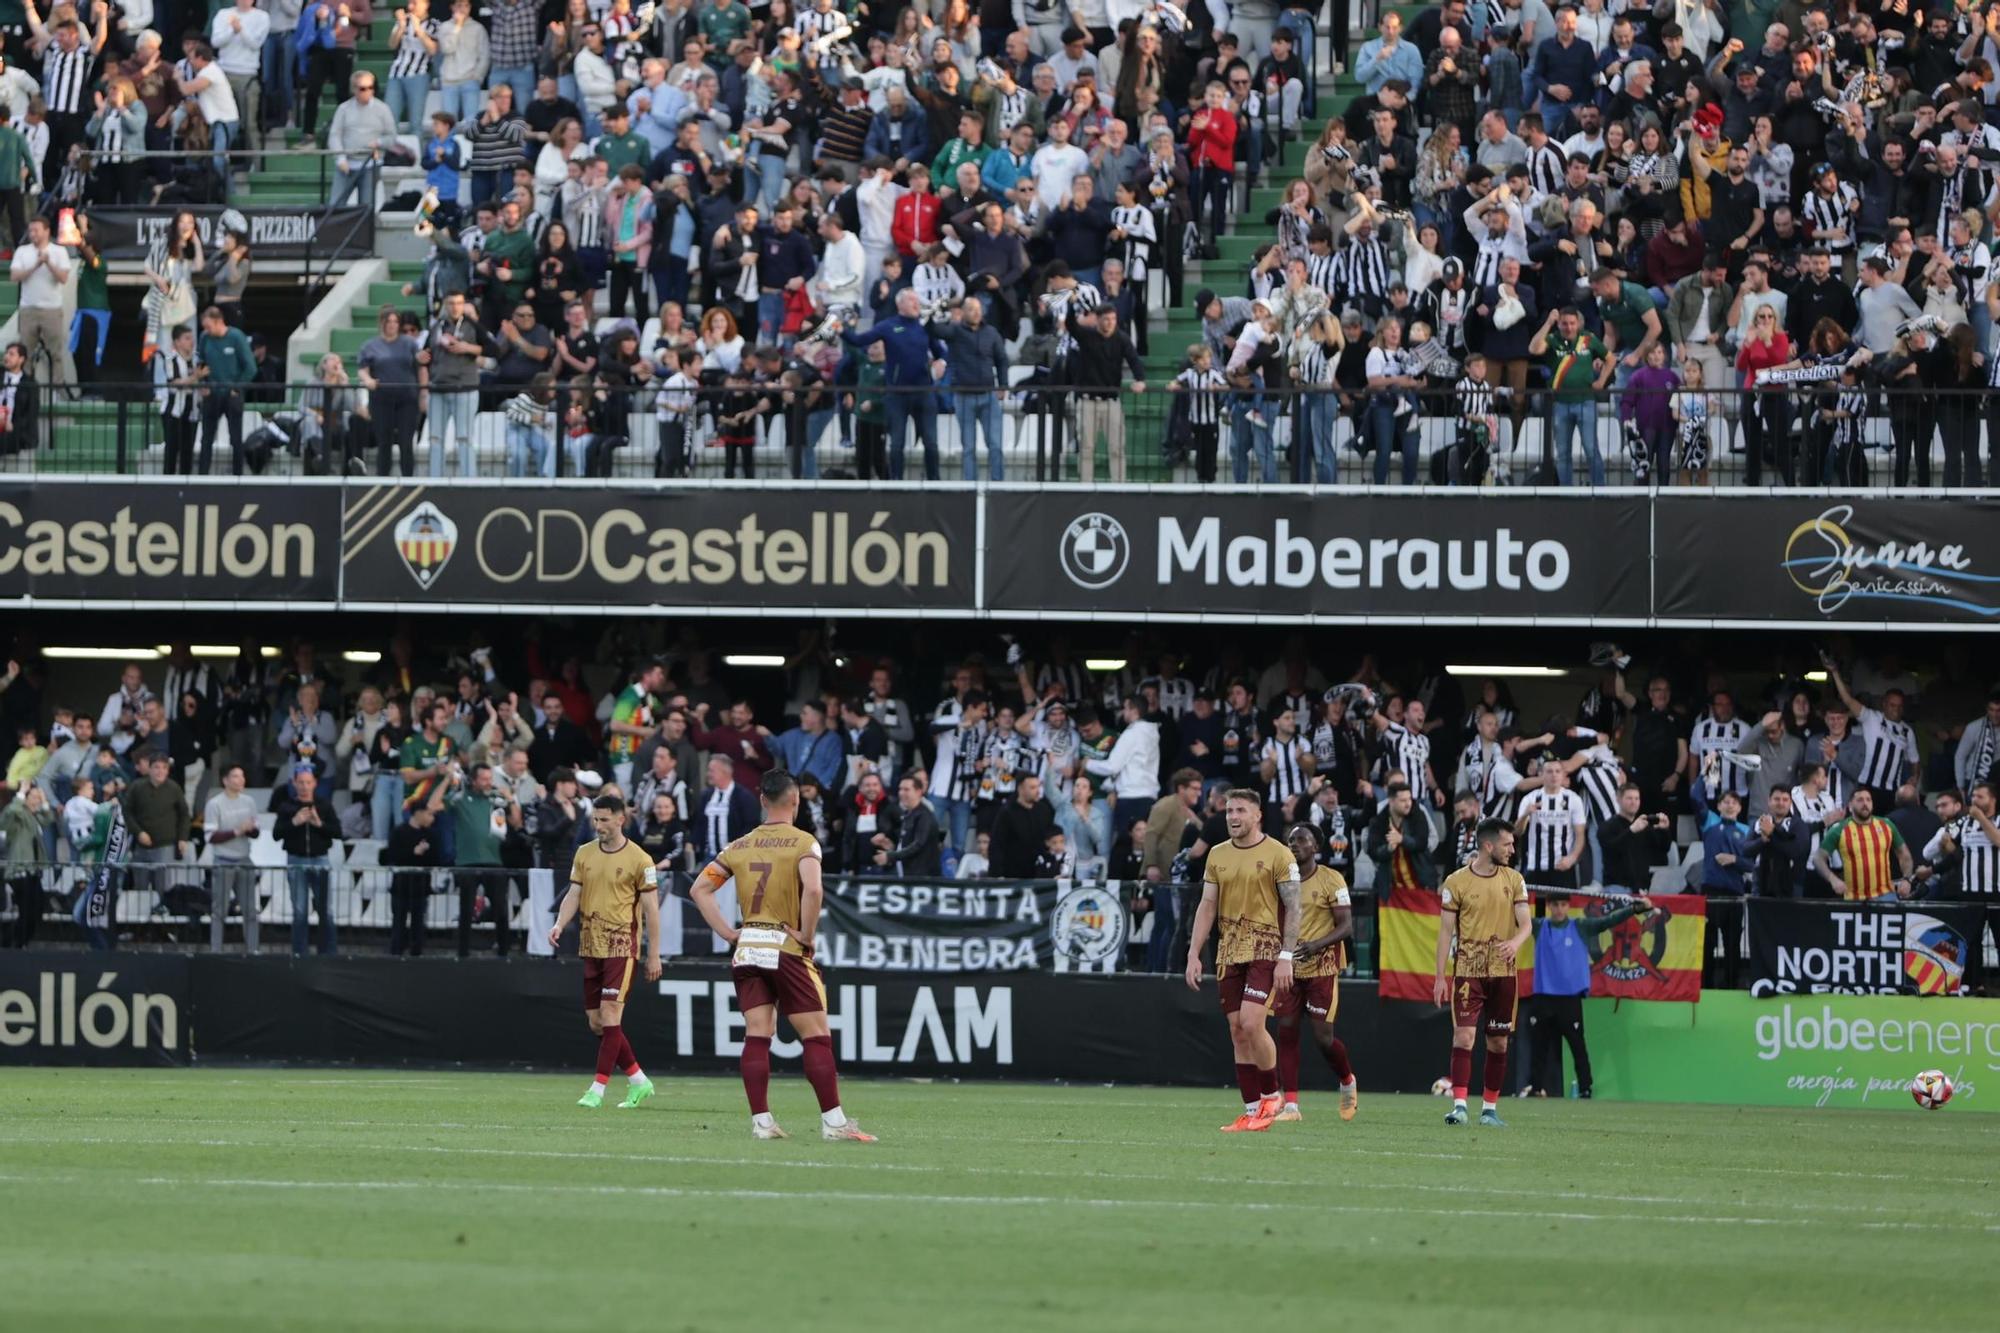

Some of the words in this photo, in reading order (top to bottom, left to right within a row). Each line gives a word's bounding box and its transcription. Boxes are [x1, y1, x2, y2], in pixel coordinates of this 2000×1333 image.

[252, 212, 317, 244] PIZZERÍA
[1157, 516, 1570, 591] Maberauto
[1810, 504, 1971, 578] Sunna
[749, 862, 773, 914] 7
[819, 884, 1041, 925] 'ESPENTA
[1830, 912, 1903, 948] THE
[812, 933, 1039, 971] ALBINEGRA
[1777, 945, 1903, 986] NORTH
[1459, 981, 1470, 998] 4
[1755, 1003, 2000, 1071] globeenerg
[1787, 1066, 1858, 1107] energía
